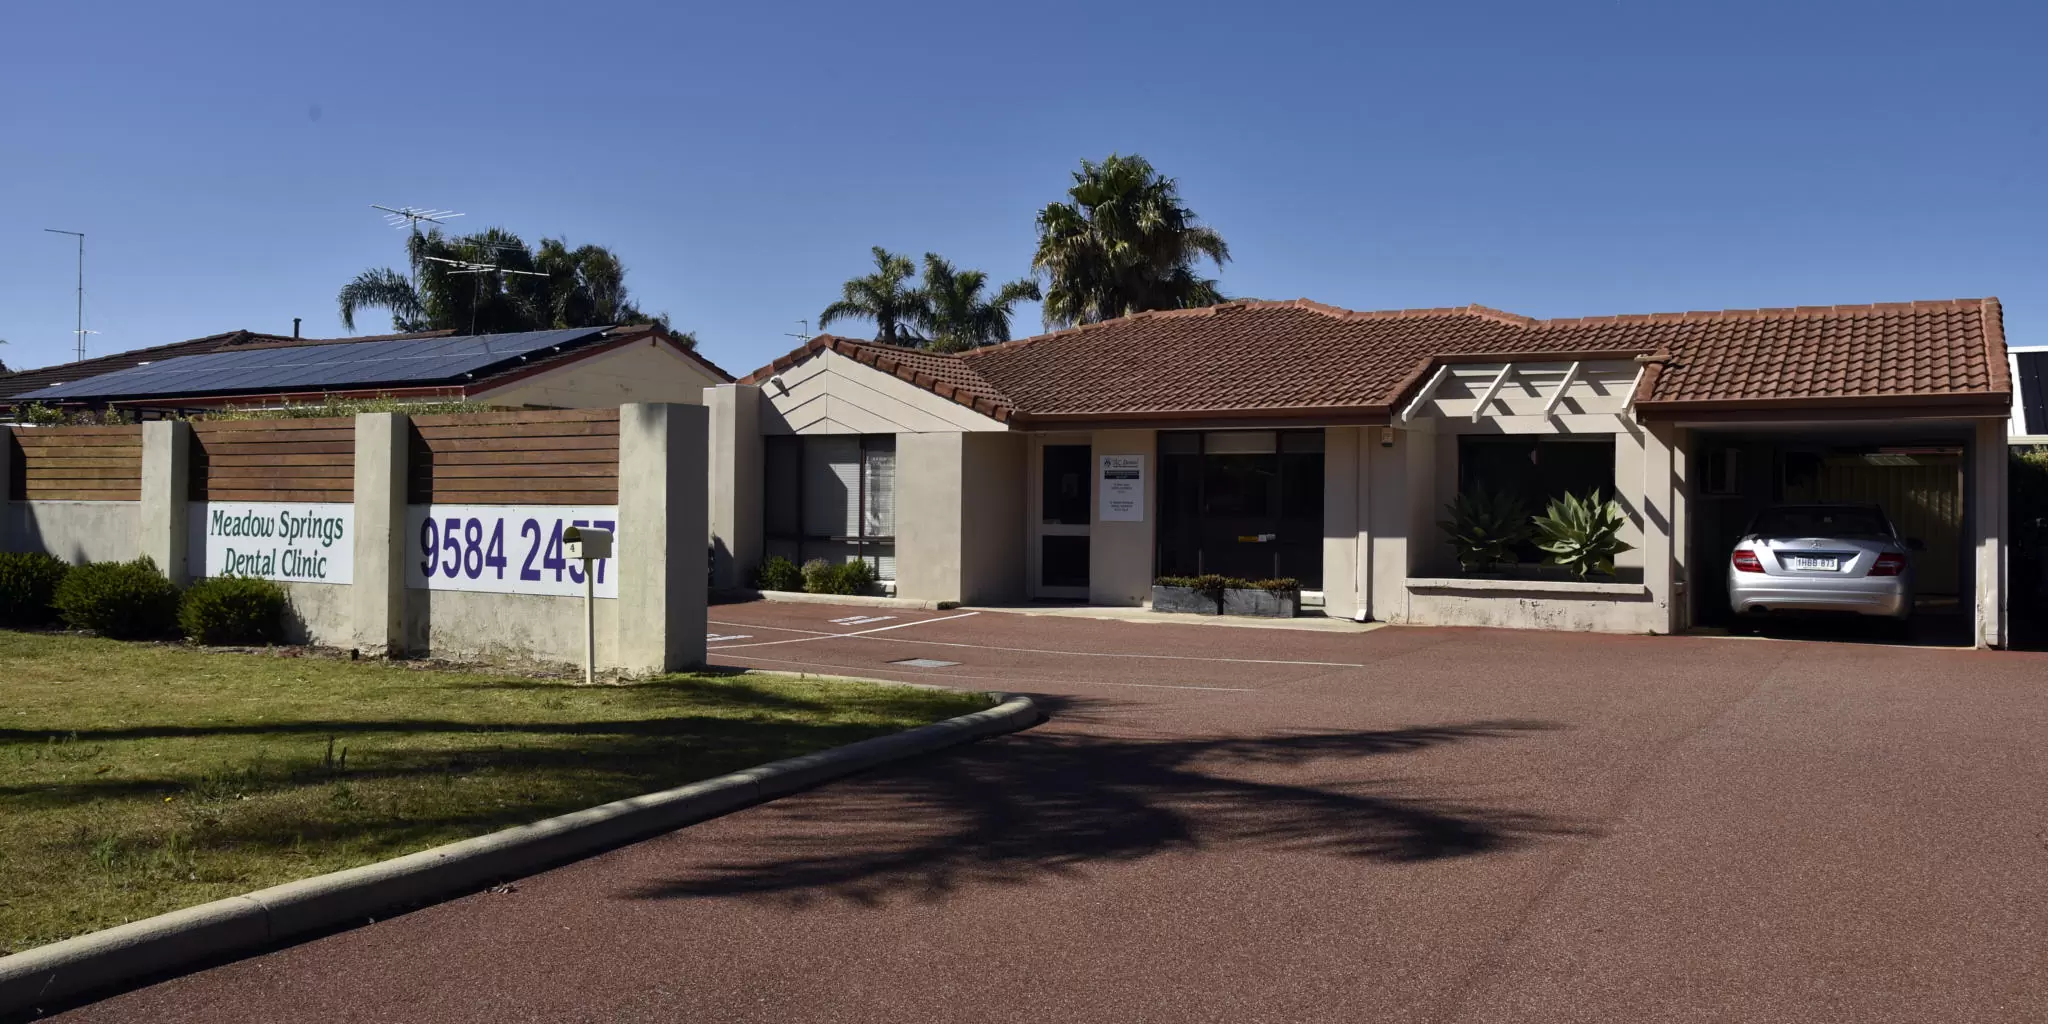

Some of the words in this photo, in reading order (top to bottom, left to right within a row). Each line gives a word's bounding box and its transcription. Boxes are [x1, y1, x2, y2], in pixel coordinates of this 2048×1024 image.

[210, 509, 275, 538] Meadow
[278, 509, 344, 548] Springs
[224, 547, 276, 576] Dental
[281, 548, 327, 579] Clinic
[420, 517, 507, 580] 9584
[569, 543, 575, 552] 4
